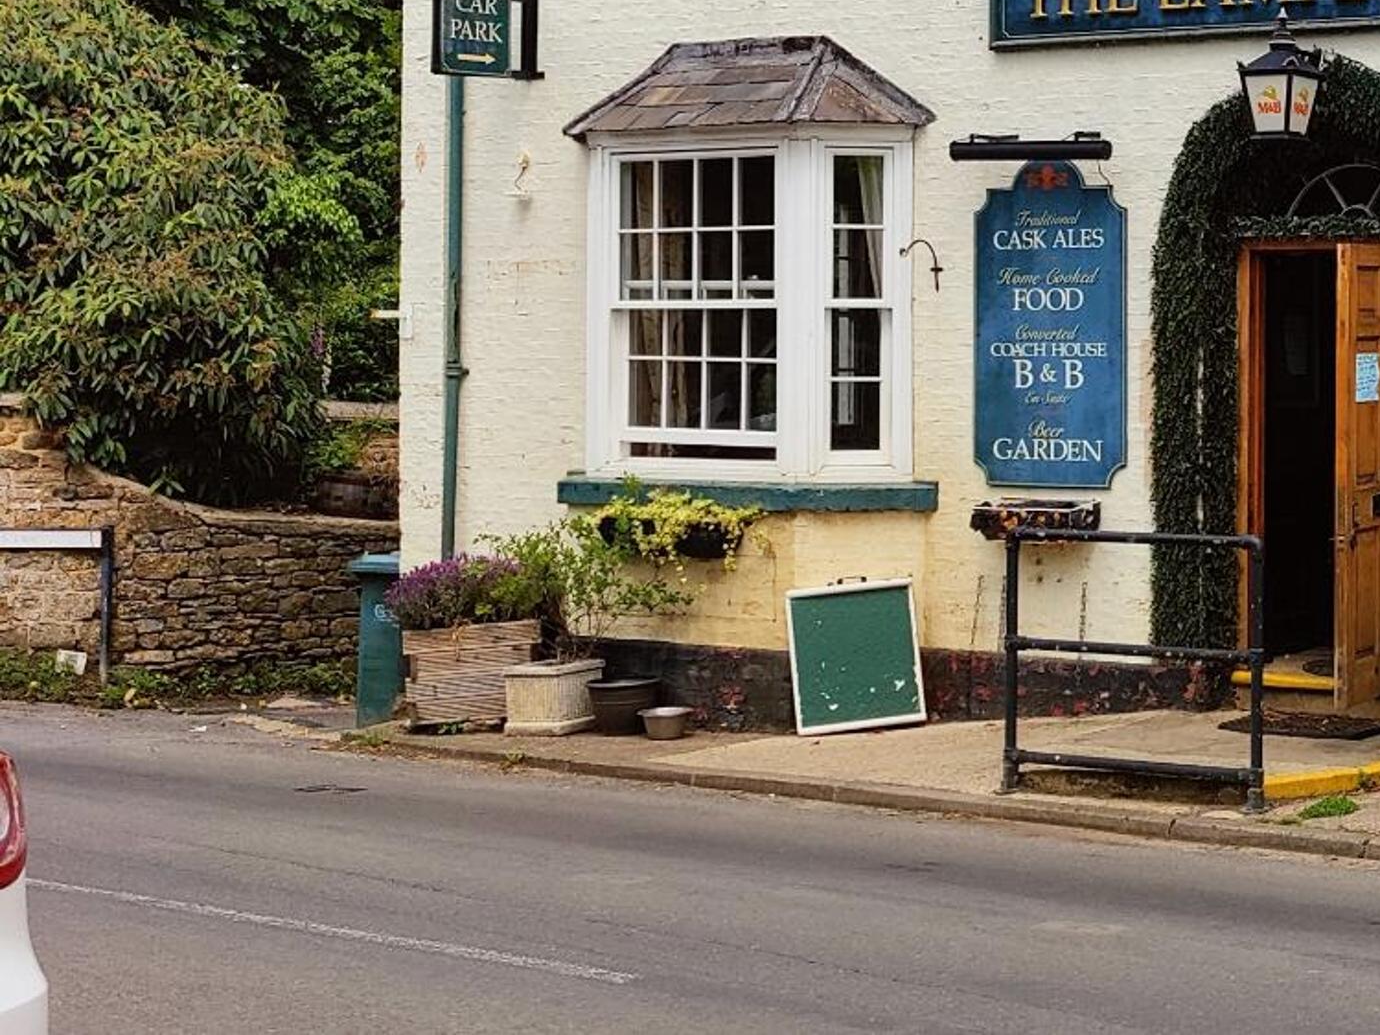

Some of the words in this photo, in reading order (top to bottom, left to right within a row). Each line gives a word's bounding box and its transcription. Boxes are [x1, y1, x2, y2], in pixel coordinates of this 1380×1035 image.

[450, 19, 503, 43] PARK
[1014, 209, 1080, 228] Traditional
[993, 229, 1047, 251] CASK
[1052, 228, 1104, 249] ALES
[996, 268, 1042, 286] Home
[1046, 266, 1100, 285] Cooked
[1012, 288, 1084, 311] FOOD
[1015, 324, 1080, 342] Converted
[990, 343, 1046, 358] COACH
[1051, 342, 1107, 357] HOUSE
[1013, 359, 1034, 389] B
[1040, 363, 1057, 383] &
[1063, 359, 1085, 389] B
[1028, 418, 1064, 438] Beer
[993, 439, 1104, 462] GARDEN
